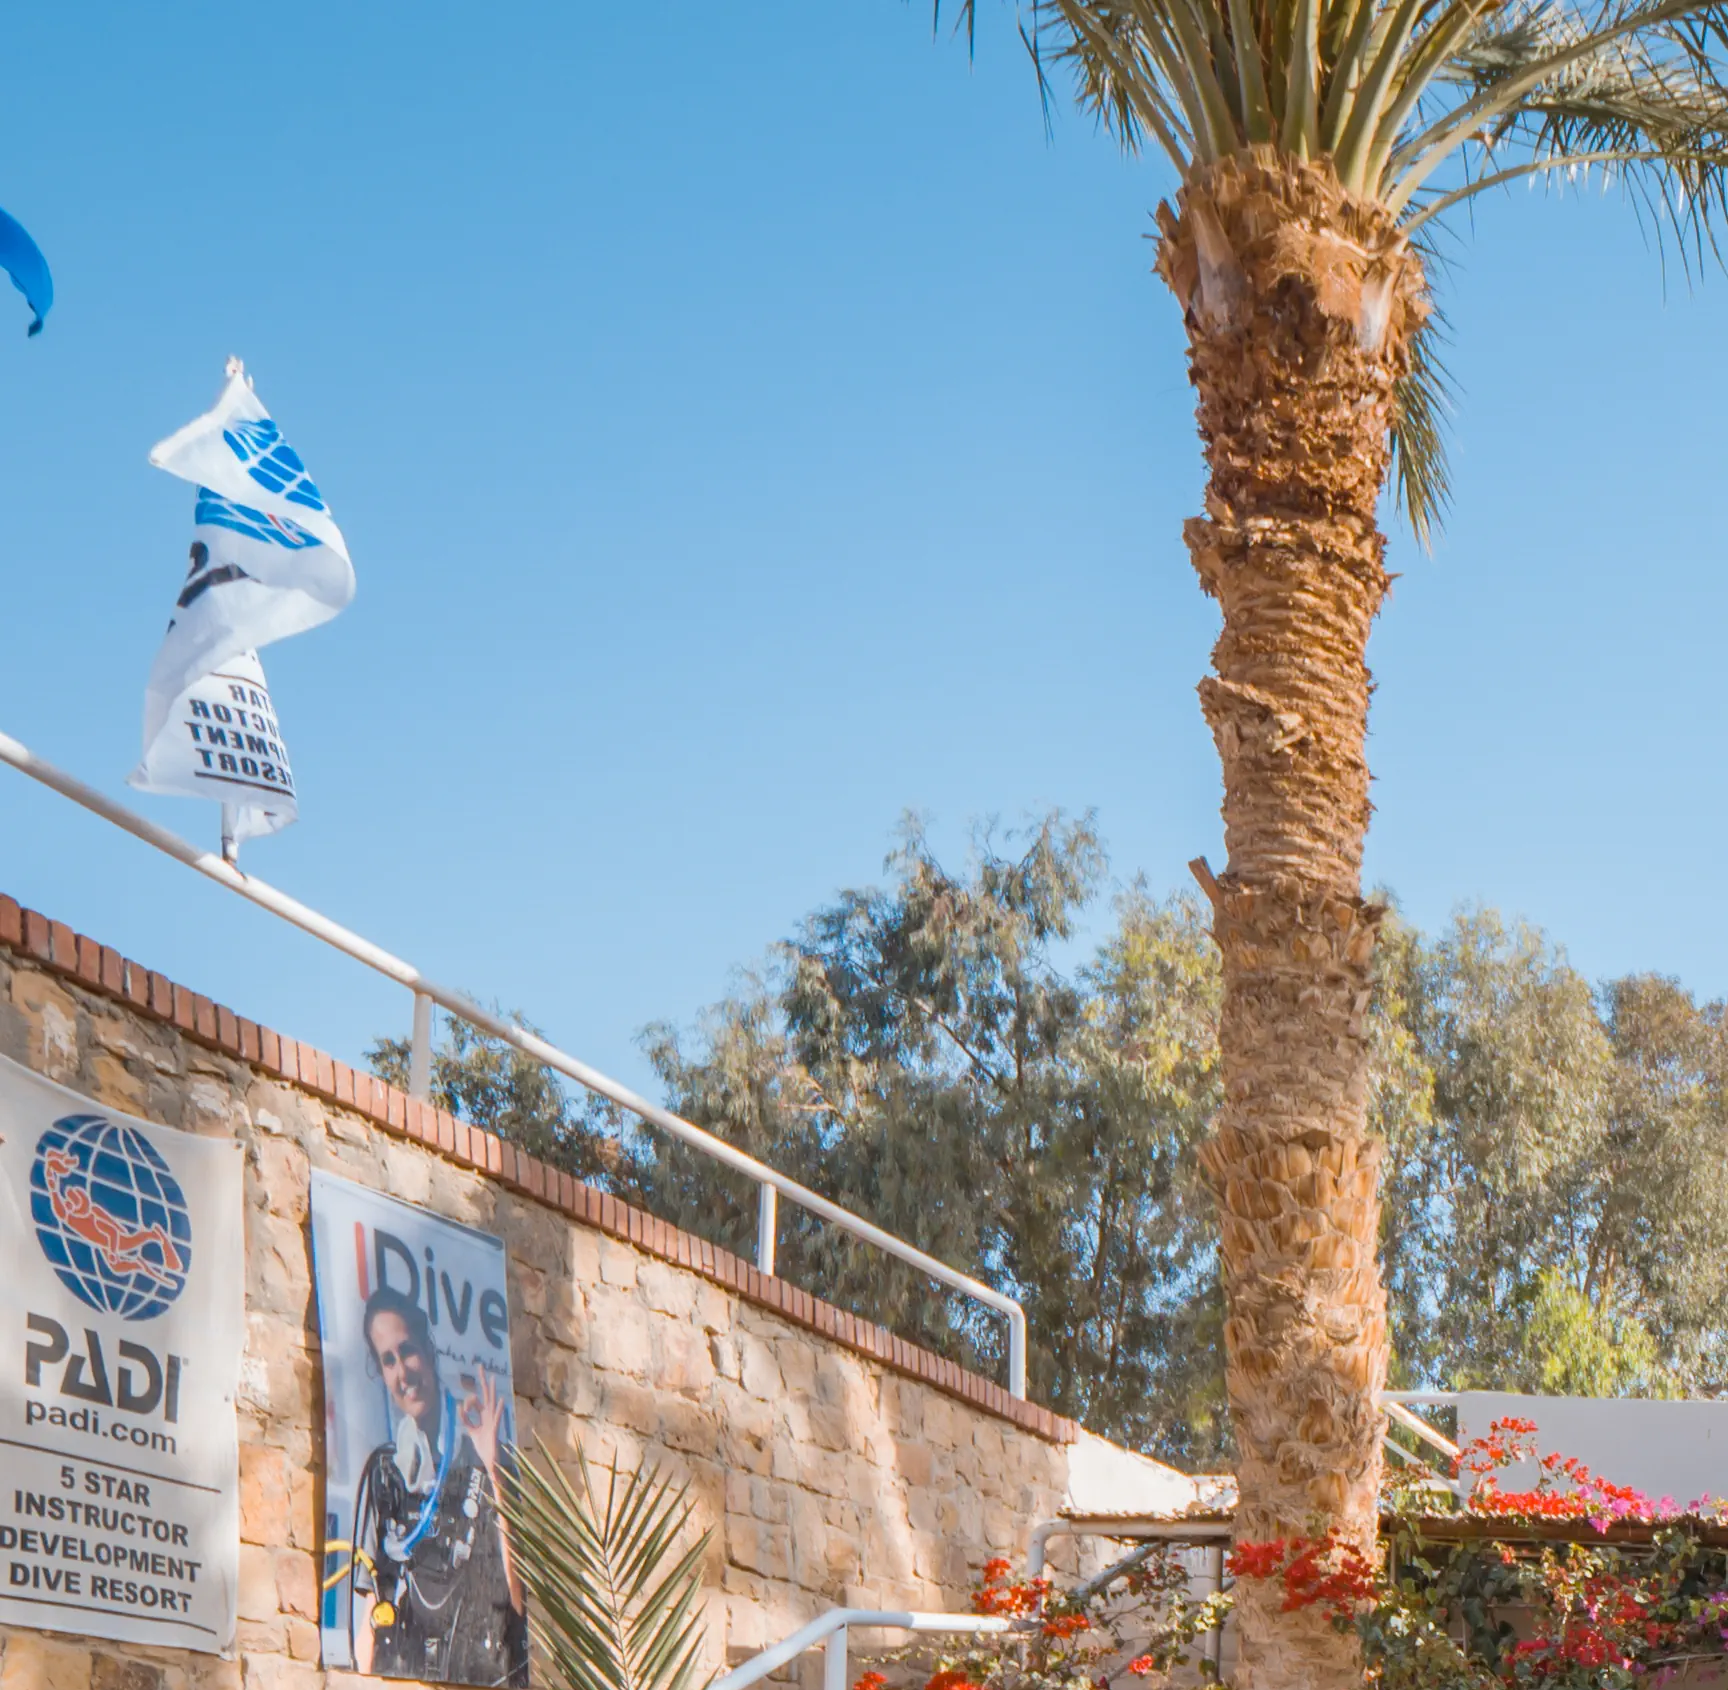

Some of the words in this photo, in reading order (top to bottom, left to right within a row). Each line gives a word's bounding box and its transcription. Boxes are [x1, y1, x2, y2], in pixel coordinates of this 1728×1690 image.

[25, 1311, 181, 1424] PADI
[25, 1399, 177, 1455] padi.com
[60, 1465, 75, 1489] 5
[85, 1471, 151, 1507] STAR
[14, 1489, 189, 1547] INSTRUCTOR
[0, 1525, 202, 1583] DEVELOPMENT
[9, 1562, 82, 1595] DIVE
[91, 1575, 192, 1613] RESORT
